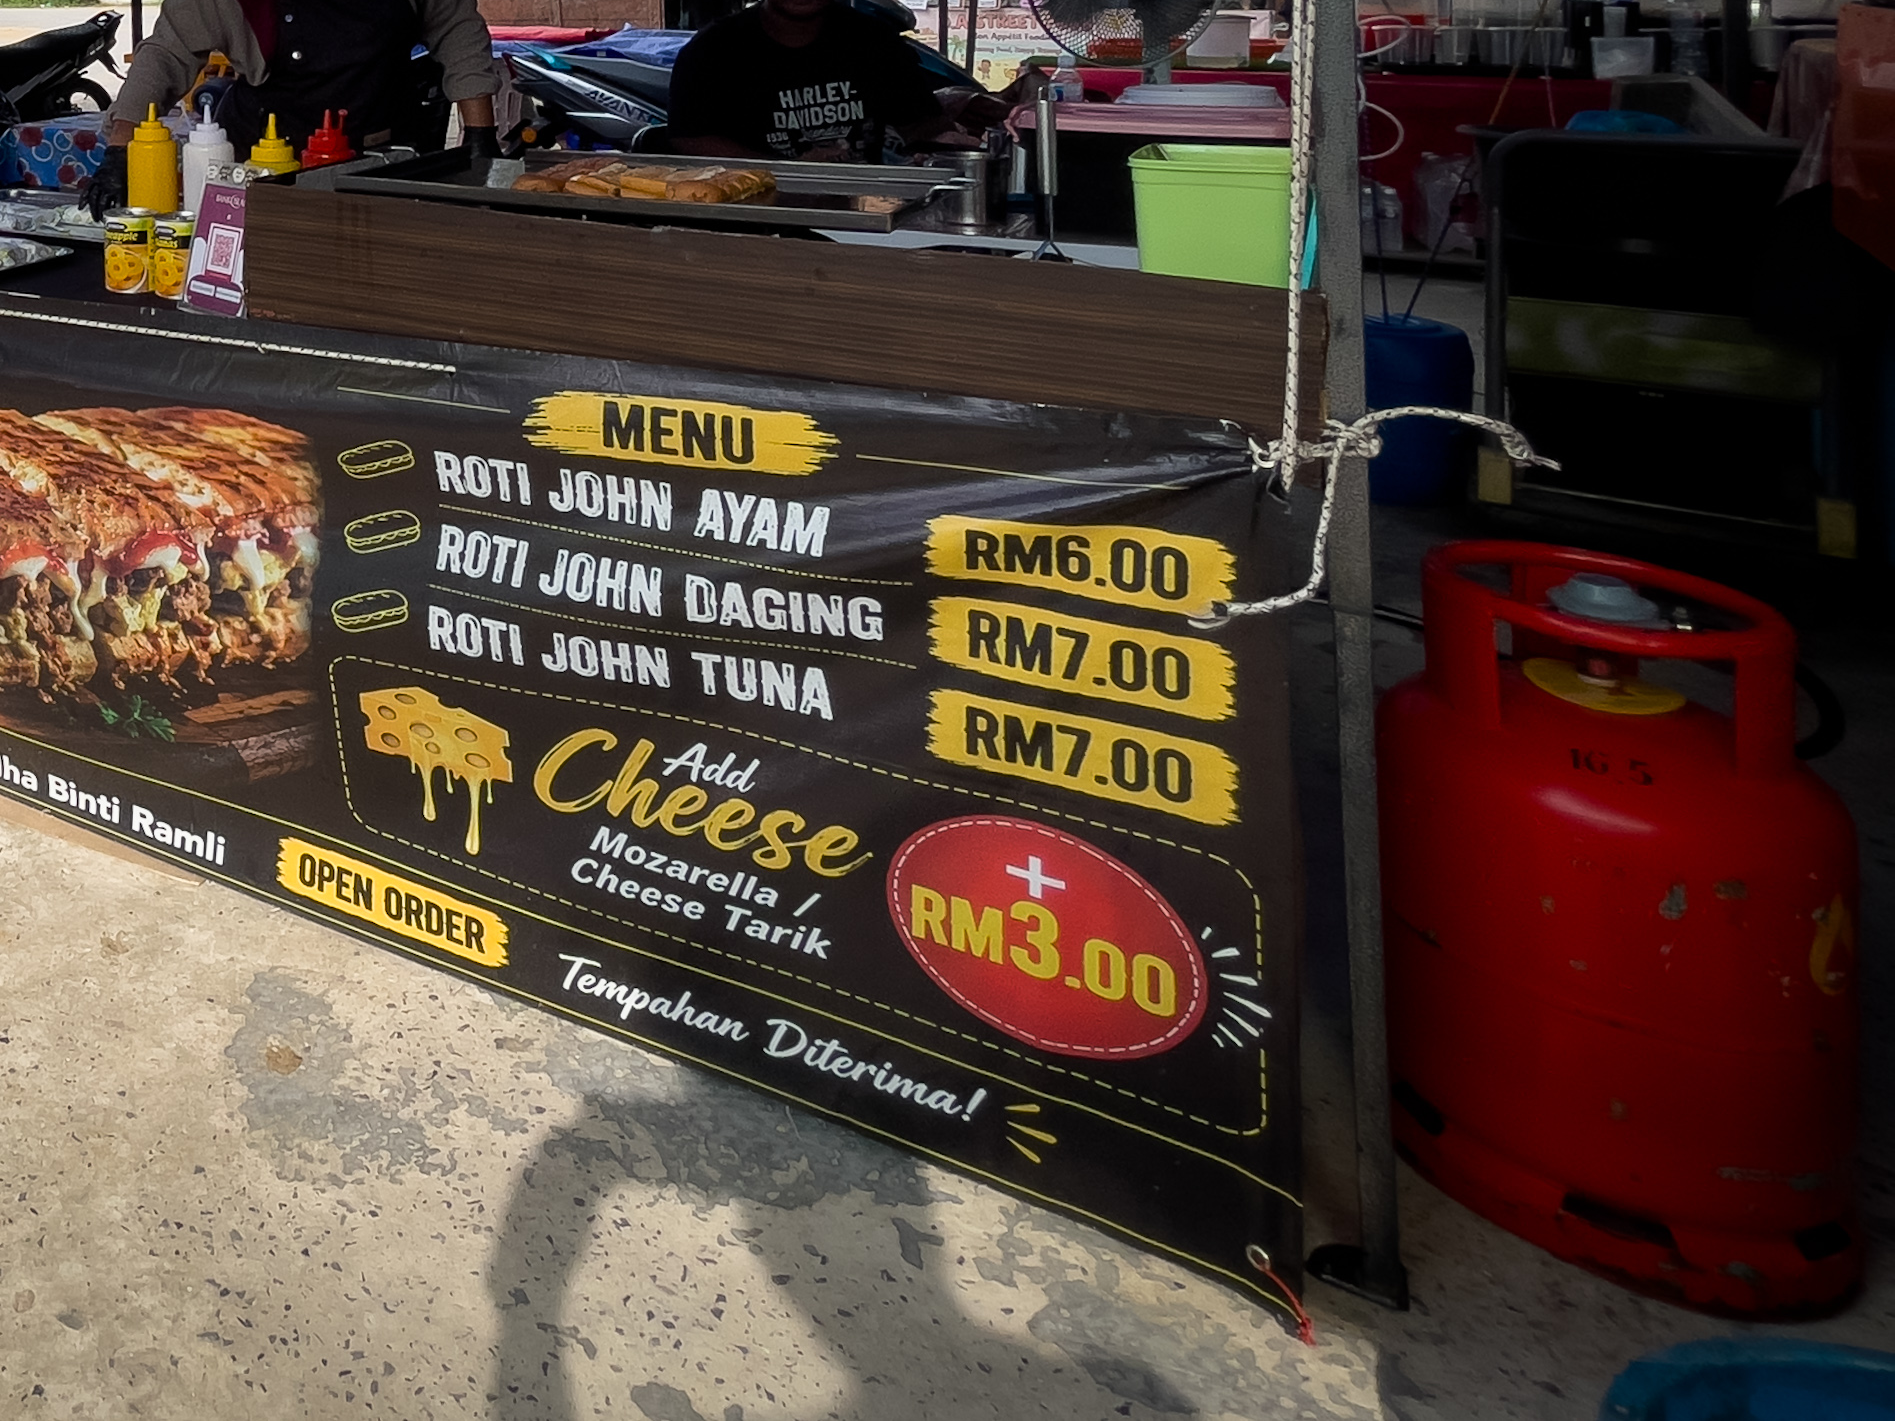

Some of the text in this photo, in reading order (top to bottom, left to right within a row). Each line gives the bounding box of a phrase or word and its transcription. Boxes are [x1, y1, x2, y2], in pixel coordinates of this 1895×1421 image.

[773, 100, 865, 130] DAVIDSON
[778, 80, 858, 109] HARLEY-
[601, 401, 755, 465] MENU
[433, 450, 1189, 601] ROTI JOHN AYAM RM6.00
[435, 524, 1191, 701] ROTI JOHN DAGING RM7.00
[427, 604, 1192, 804] ROTI JOHN TUNA RM7.00
[533, 727, 874, 878] Cheese
[661, 742, 761, 794] Add
[46, 774, 121, 824] Binti
[131, 805, 227, 866] Ramli
[589, 826, 780, 910] Mozarella
[298, 852, 486, 954] OPEN ORDER
[570, 858, 833, 960] Cheese Tarik
[910, 883, 1177, 1018] RM3.00
[557, 952, 987, 1123] Tempahan Diterima!
